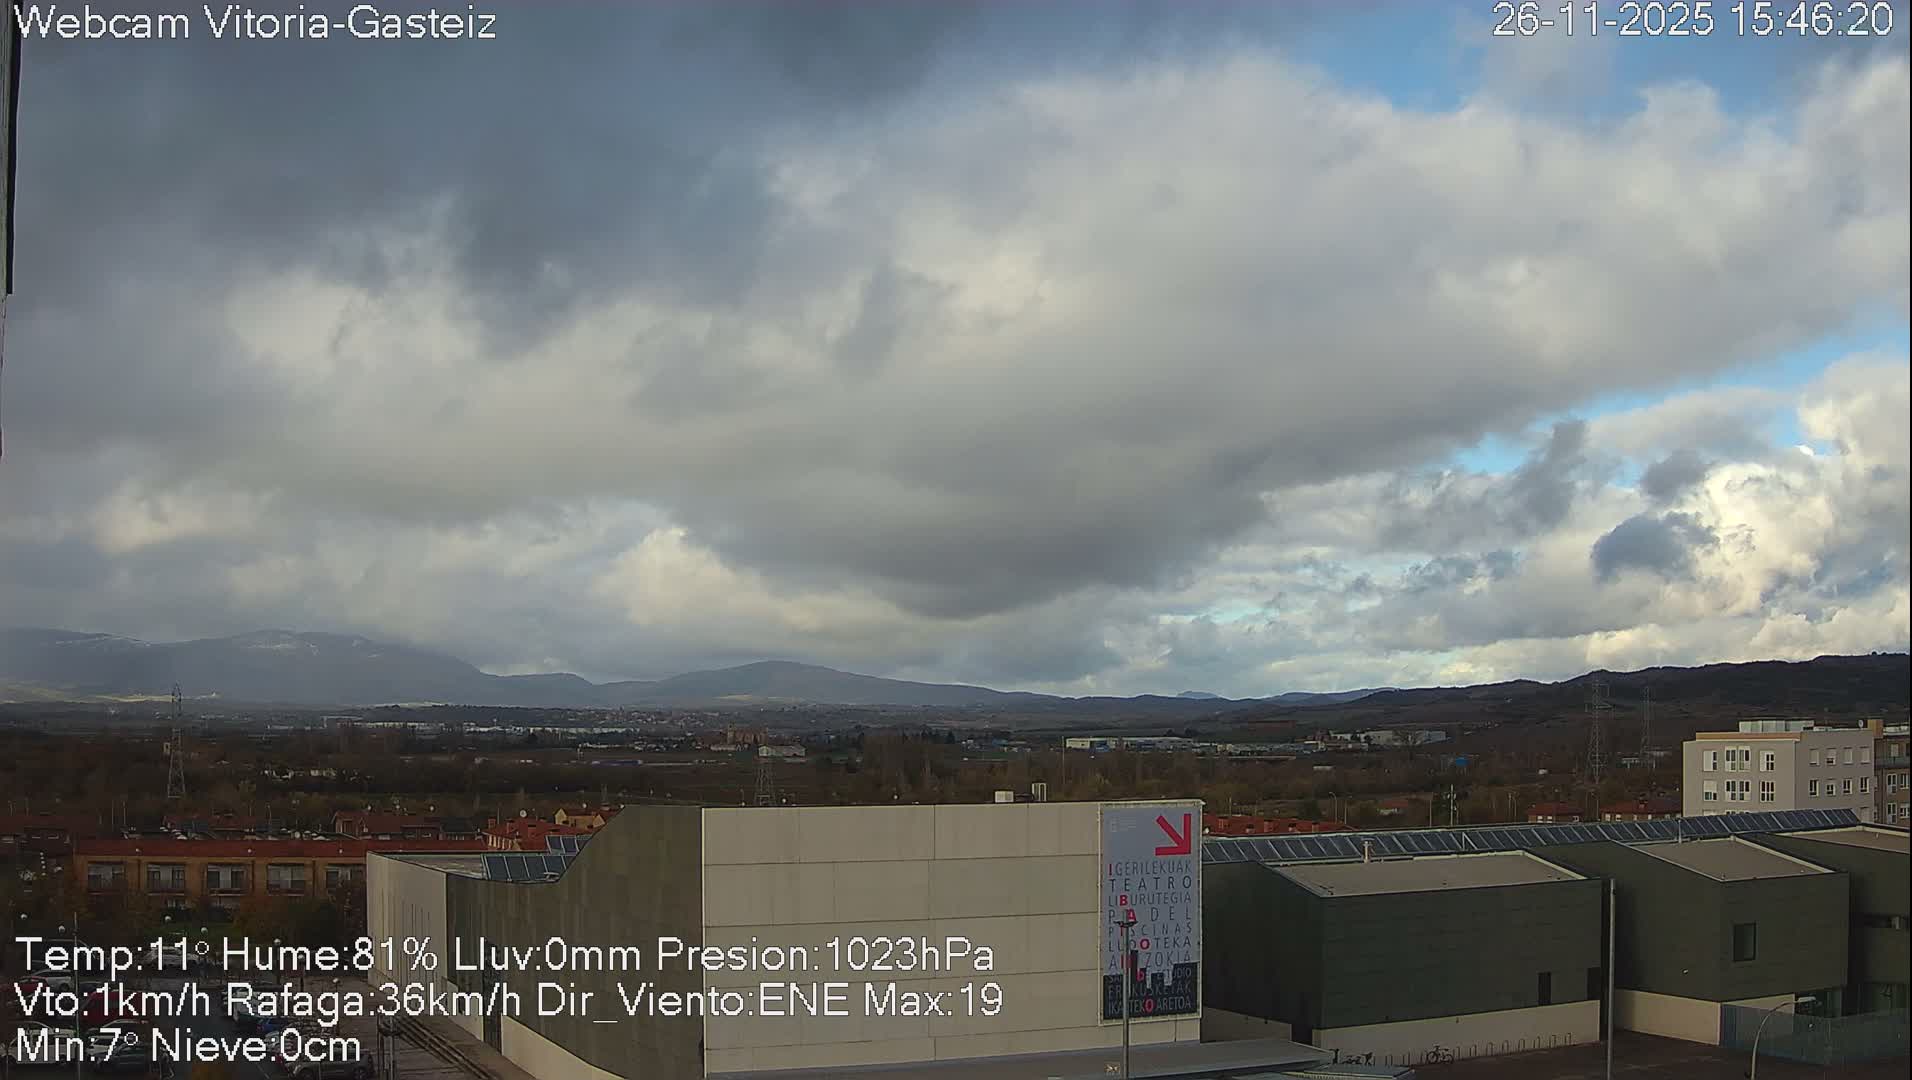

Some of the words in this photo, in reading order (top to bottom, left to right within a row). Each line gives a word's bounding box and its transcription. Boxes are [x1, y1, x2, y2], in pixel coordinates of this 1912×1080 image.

[1108, 860, 1192, 877] IGERILEKUAK
[1109, 876, 1192, 892] TEATRO
[1108, 892, 1192, 907] LIBURUTEGIA
[1108, 979, 1192, 998] ERKUSKETAK
[1156, 996, 1192, 1011] ARETOA
